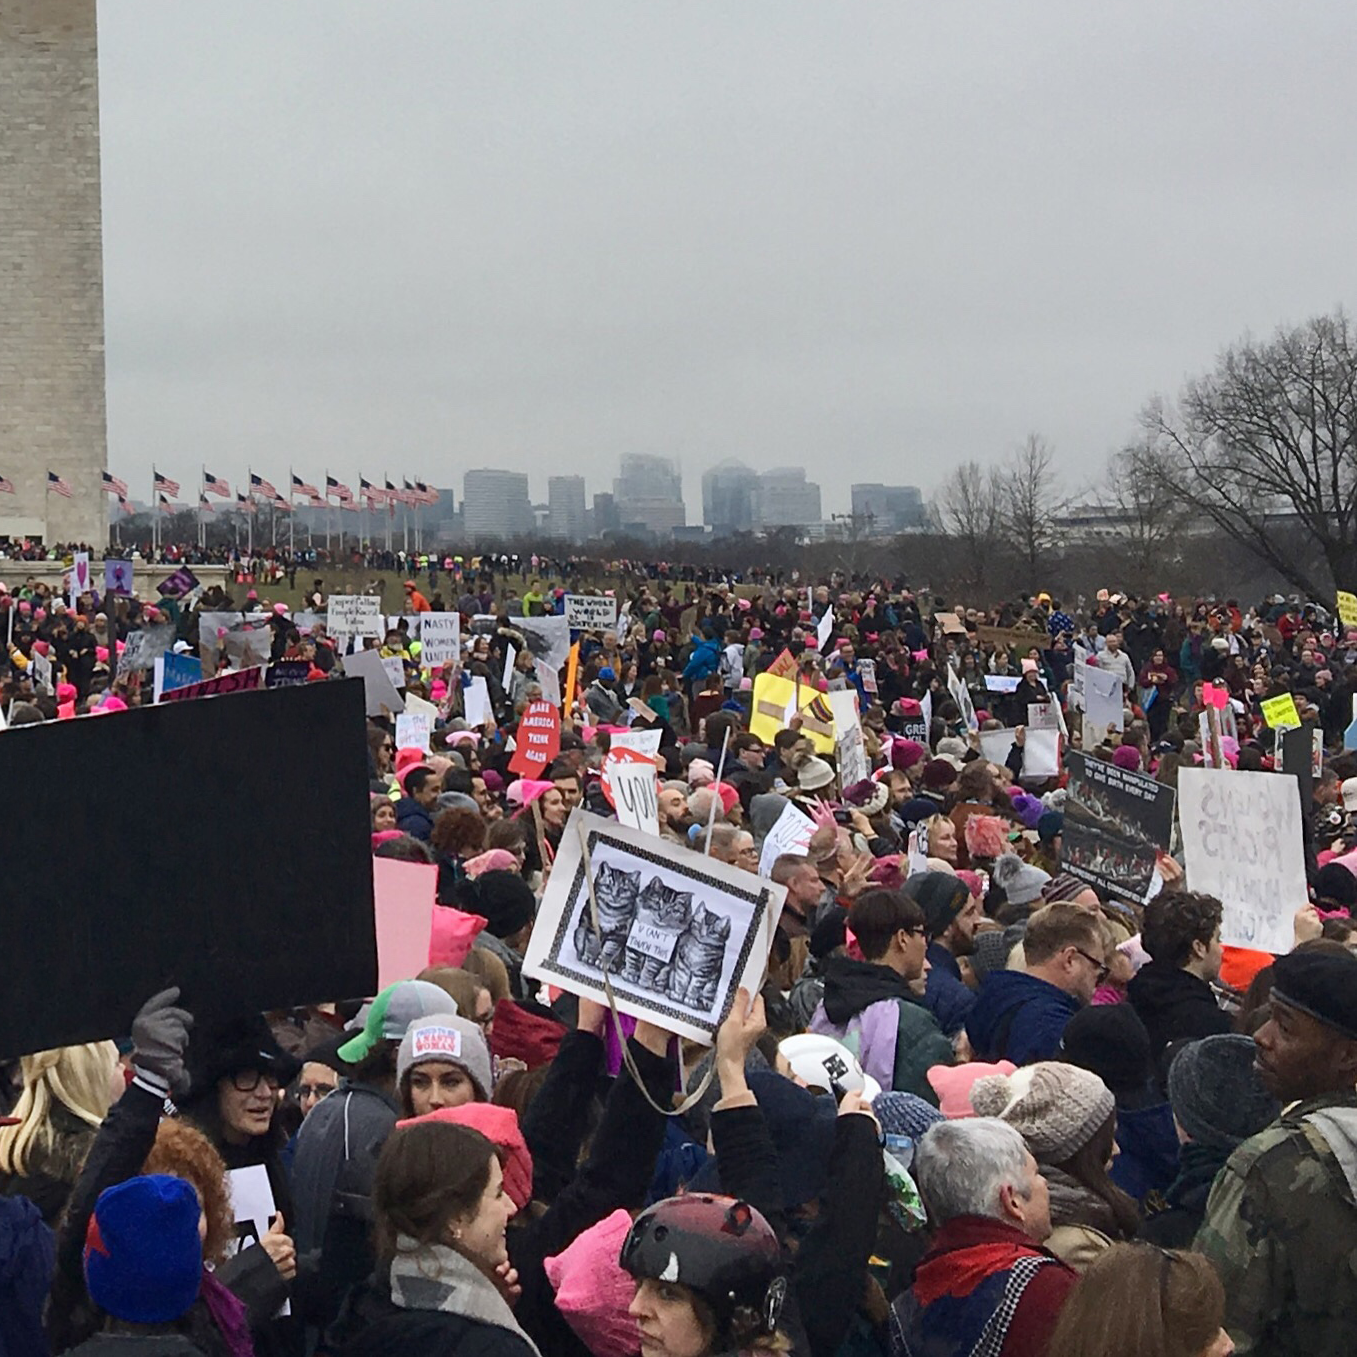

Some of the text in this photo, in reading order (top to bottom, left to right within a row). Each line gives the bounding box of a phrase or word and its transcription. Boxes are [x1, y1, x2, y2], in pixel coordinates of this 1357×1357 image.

[567, 598, 614, 607] THE WHOLE
[572, 608, 611, 617] WORLD
[424, 618, 455, 629] NASTY
[424, 637, 457, 648] WOMEN
[425, 650, 456, 663] UNITE
[529, 701, 551, 714] MAKE
[522, 716, 555, 729] AMERICA
[1085, 768, 1093, 778] TO
[1125, 782, 1144, 798] EVERY
[1144, 790, 1157, 802] DAY
[1122, 772, 1160, 794] MANIPULATED
[646, 926, 670, 943] CAN'T
[653, 945, 669, 960] THIS
[416, 1027, 437, 1037] PROUD
[423, 1034, 456, 1043] NASTY
[416, 1042, 455, 1052] WOMAN
